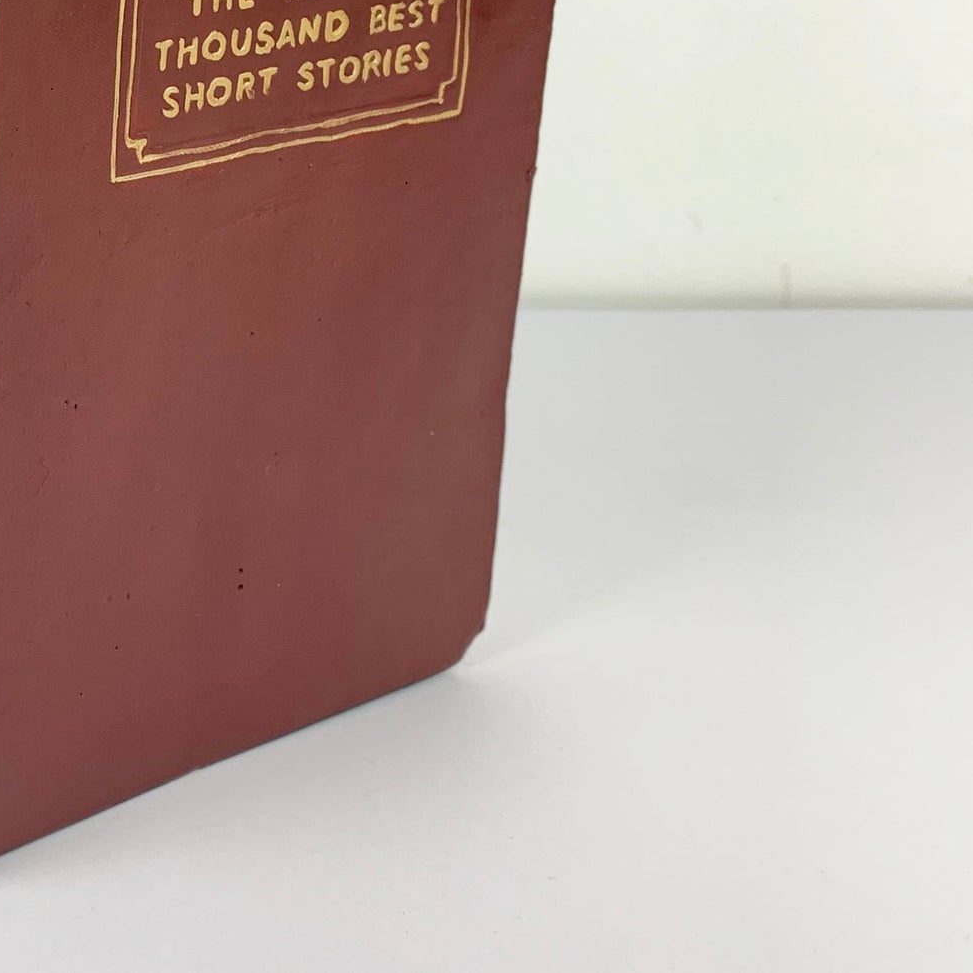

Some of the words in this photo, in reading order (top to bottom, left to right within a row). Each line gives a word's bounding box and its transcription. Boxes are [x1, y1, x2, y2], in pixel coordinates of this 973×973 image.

[155, 9, 350, 72] THOUSAND
[162, 66, 278, 119] SHORT
[296, 41, 431, 92] STORIES
